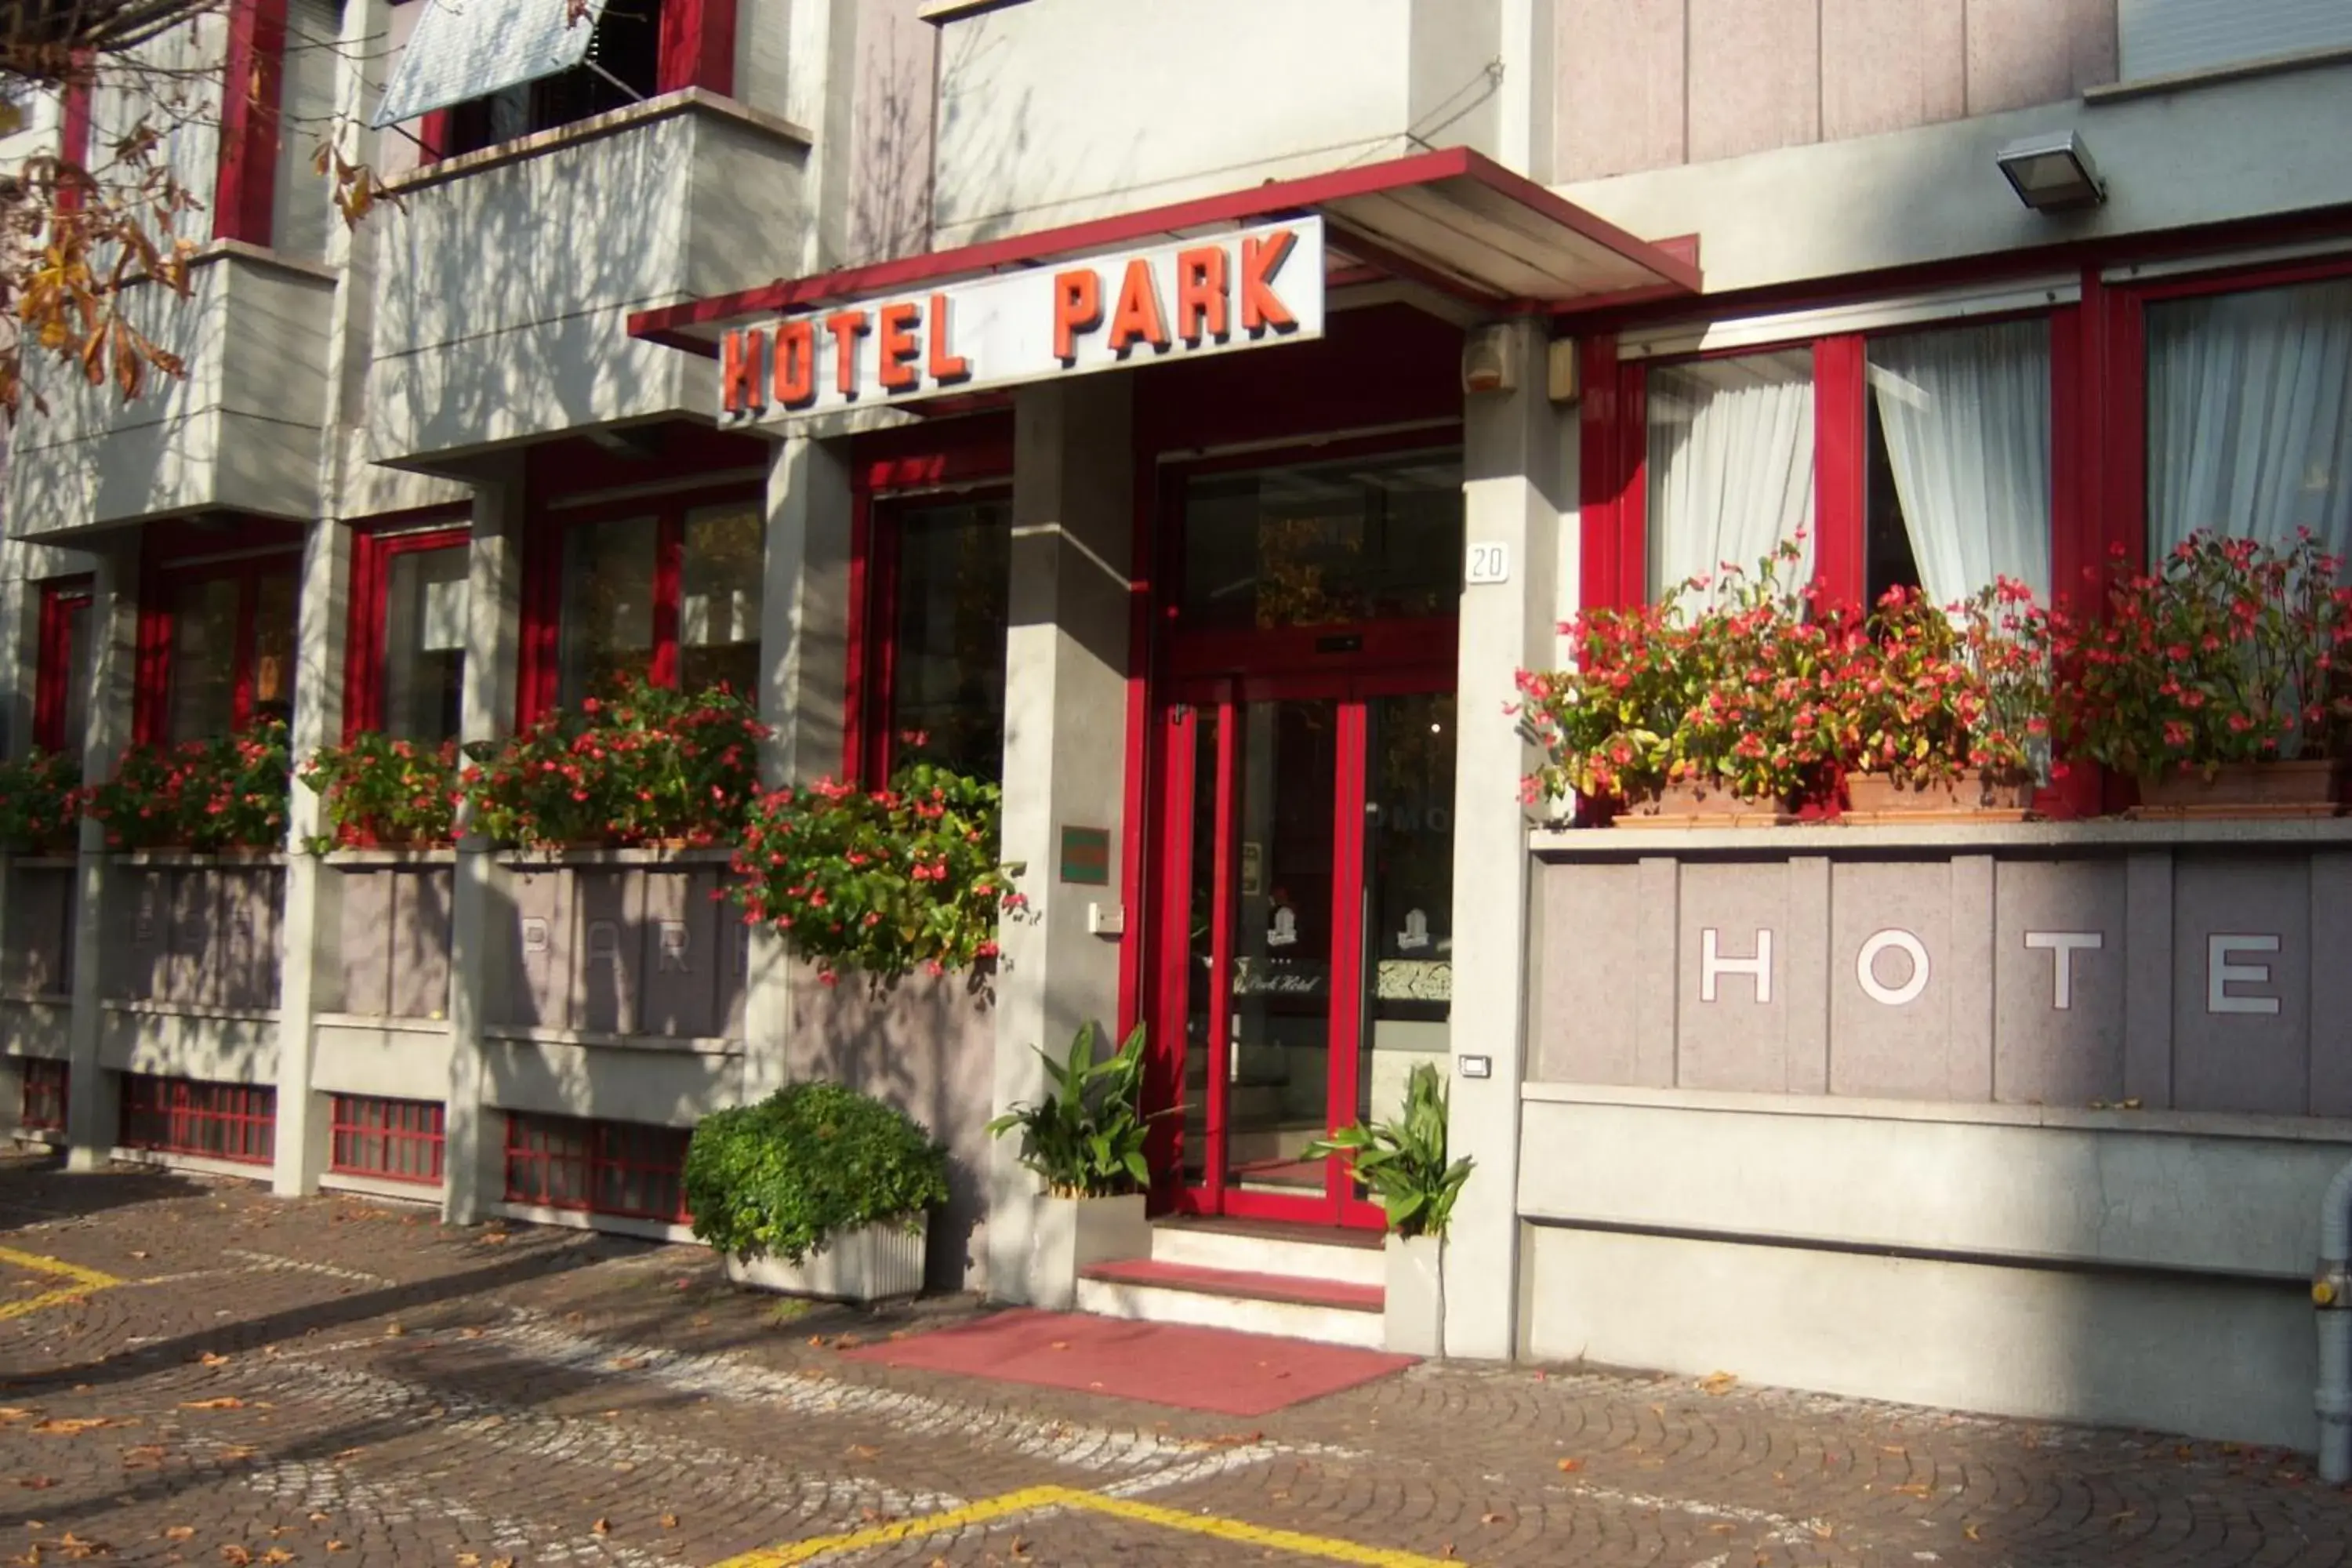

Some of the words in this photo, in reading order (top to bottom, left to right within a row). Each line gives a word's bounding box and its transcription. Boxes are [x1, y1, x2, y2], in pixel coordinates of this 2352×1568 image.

[722, 292, 967, 415] HOTEL
[1054, 228, 1300, 361] PARK
[1472, 546, 1503, 577] 20
[1698, 927, 2282, 1015] HOTE
